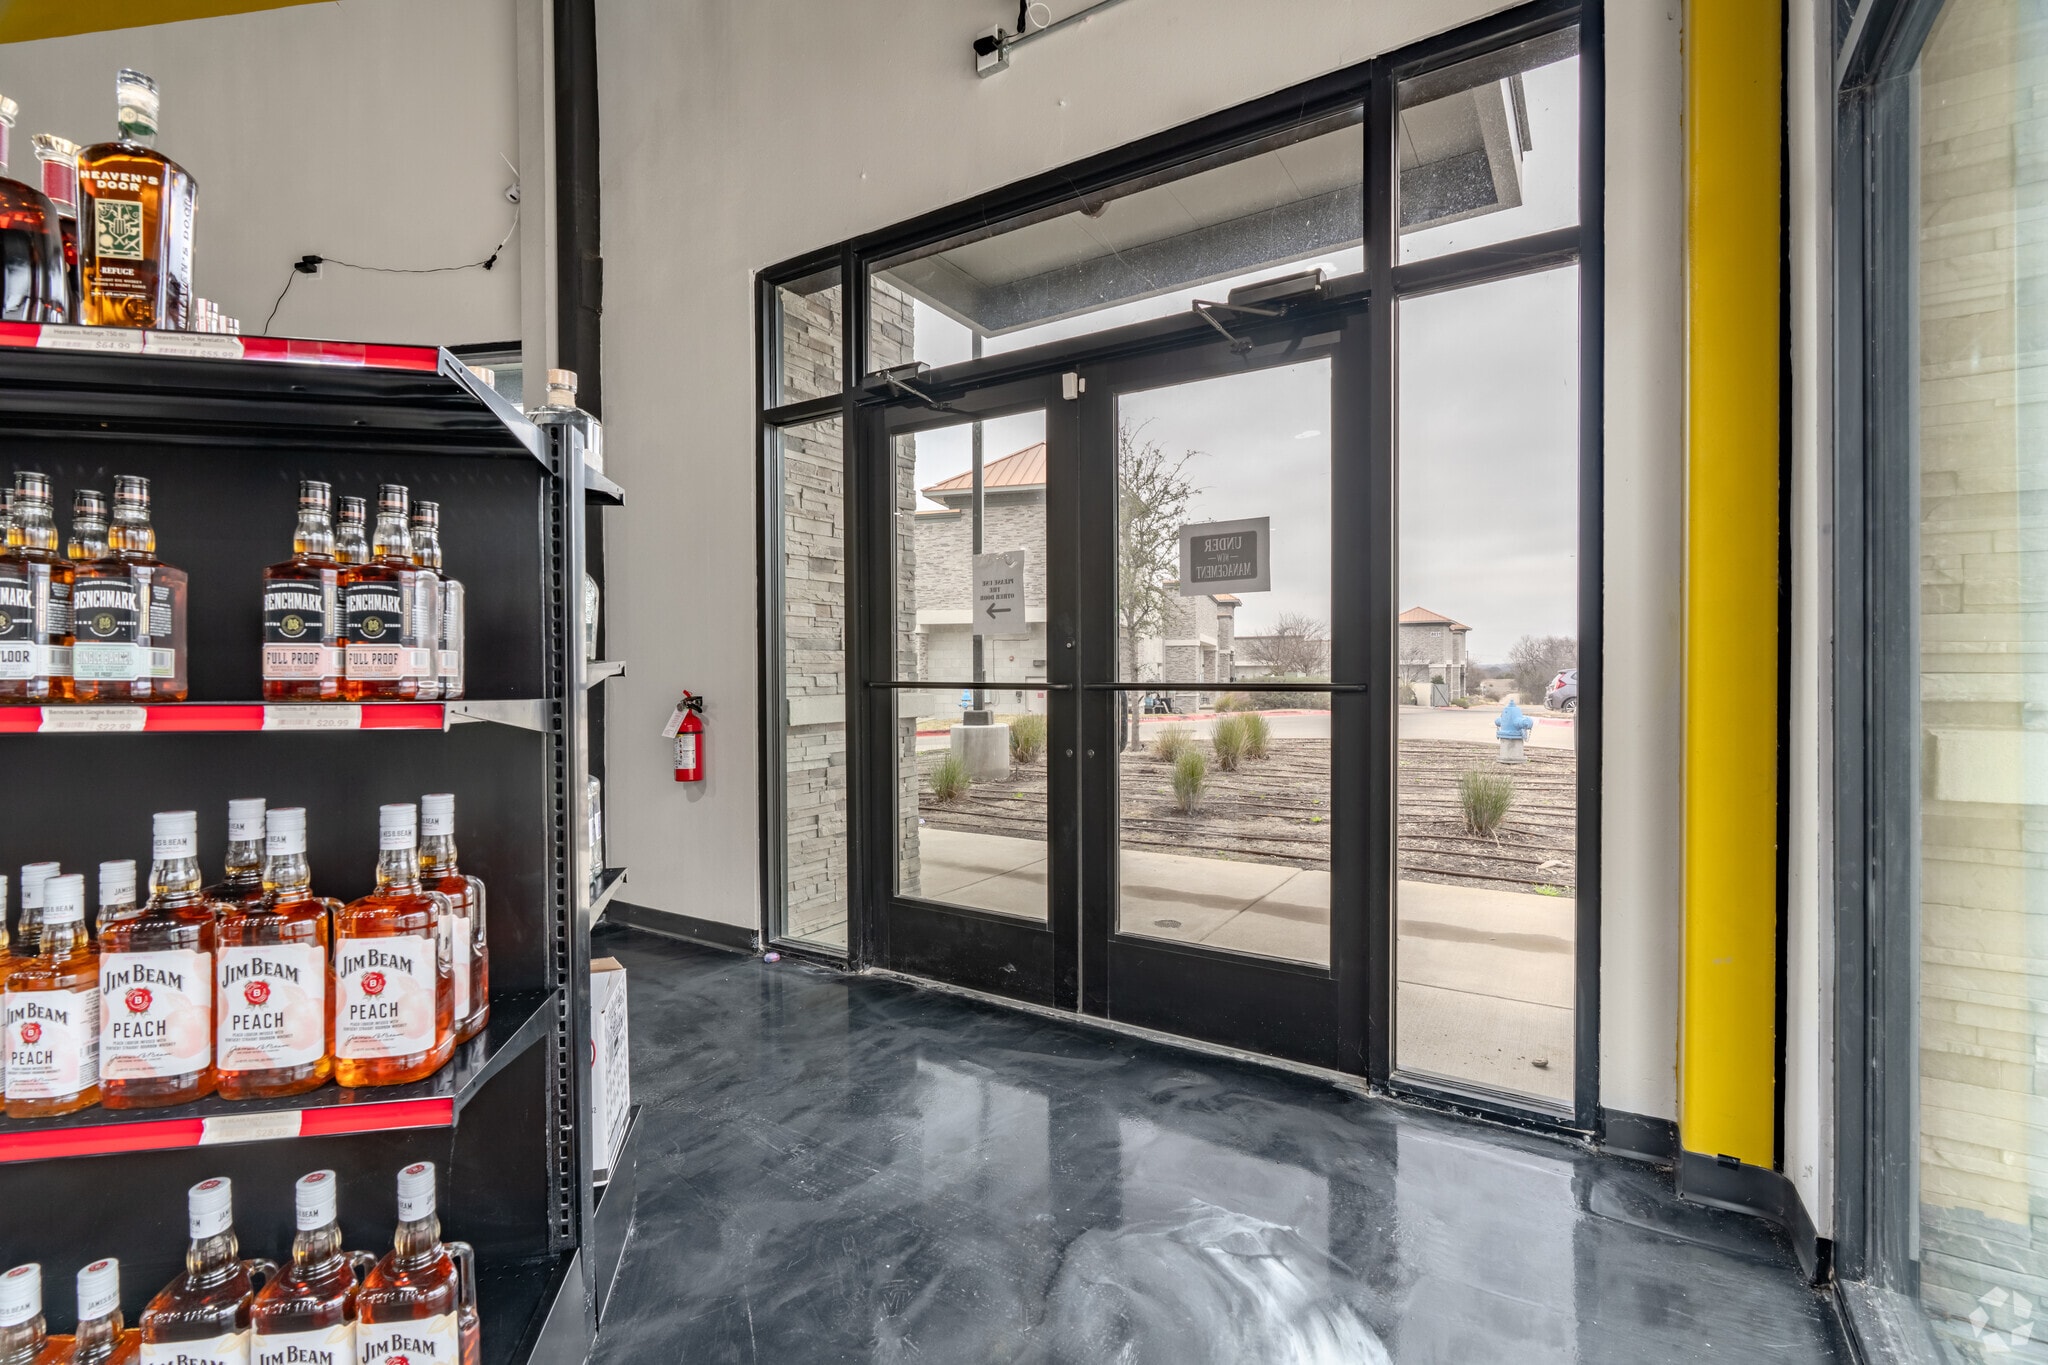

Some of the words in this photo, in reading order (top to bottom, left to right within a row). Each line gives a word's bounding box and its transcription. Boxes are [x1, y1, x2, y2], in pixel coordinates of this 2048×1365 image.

[80, 170, 158, 185] HEAVEN'S
[97, 180, 140, 192] DOOR
[102, 266, 134, 276] REFUGE
[74, 590, 139, 612] BENCHMARK
[267, 652, 288, 664] FULL
[292, 652, 320, 664] PROOF
[349, 653, 368, 664] FULL
[372, 653, 398, 664] PROOF
[169, 838, 187, 846] BEAM
[222, 964, 248, 988] JIM
[252, 958, 299, 985] BEAM
[341, 955, 365, 979] JIM
[368, 949, 412, 975] BEAM
[104, 970, 130, 995] JIM
[134, 964, 183, 992] BEAM
[7, 1007, 24, 1027] JIM
[28, 1002, 68, 1025] BEAM
[350, 1002, 398, 1020] PEACH
[114, 1020, 166, 1038] PEACH
[233, 1012, 283, 1030] PEACH
[12, 1051, 52, 1065] PEACH
[287, 1346, 332, 1365] BEAM
[362, 1340, 389, 1364] JIM
[392, 1334, 436, 1357] BEAM
